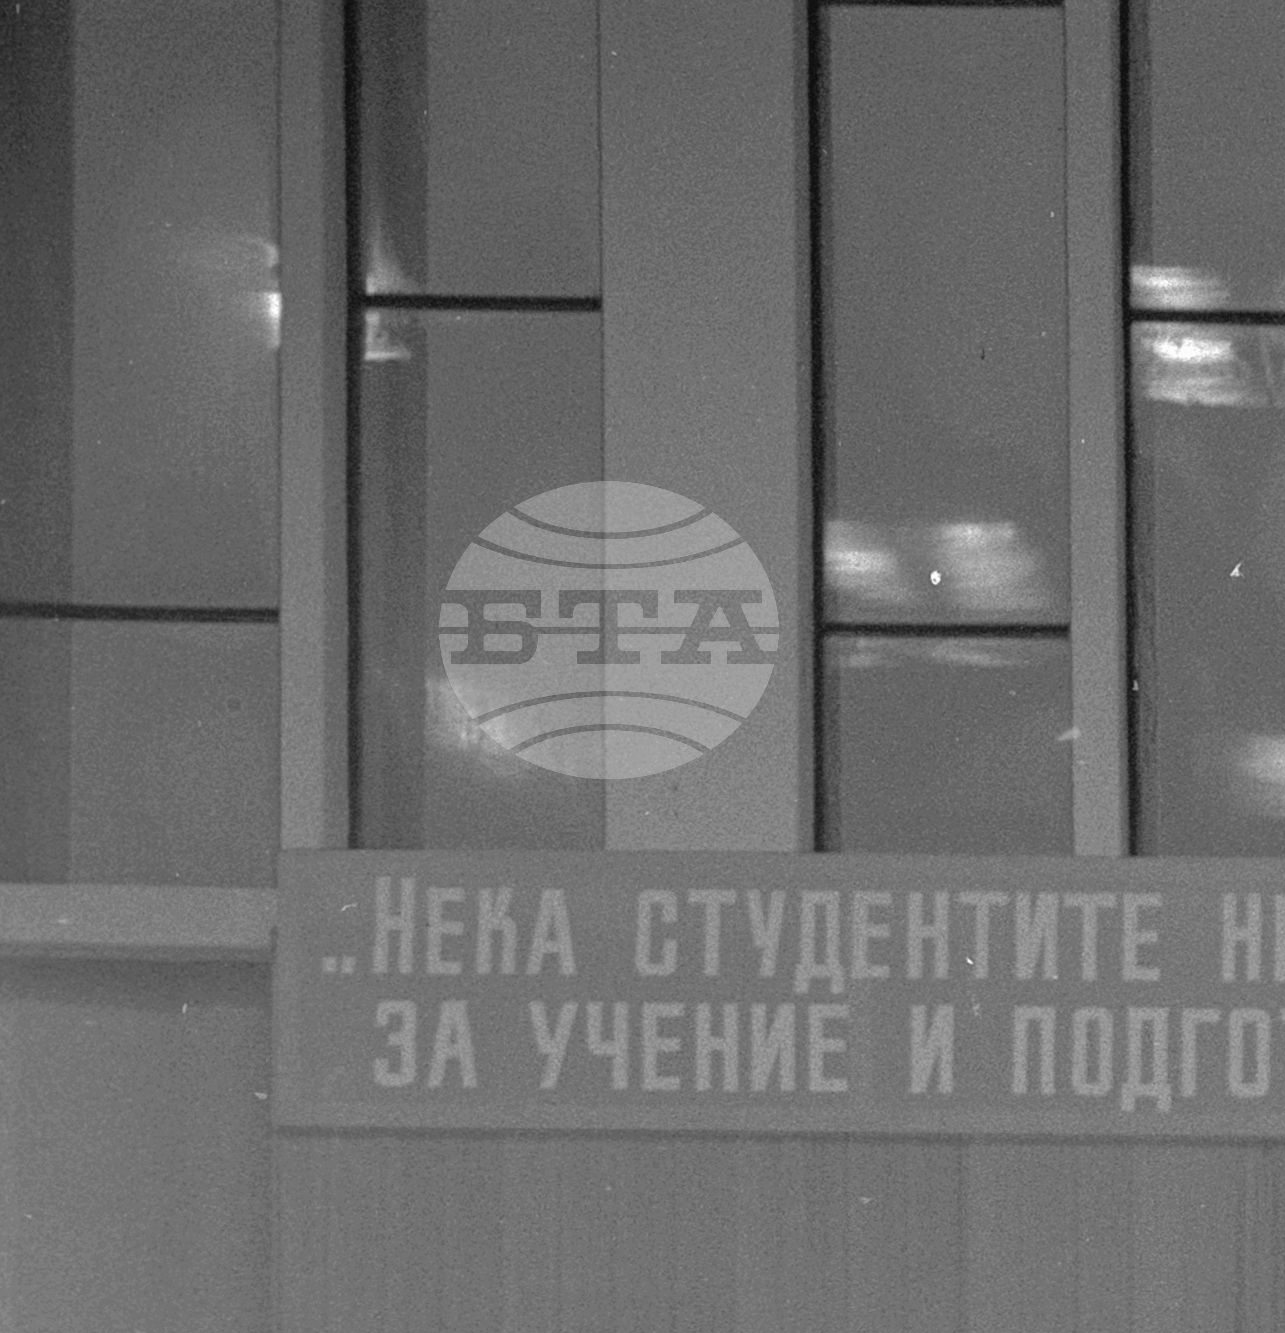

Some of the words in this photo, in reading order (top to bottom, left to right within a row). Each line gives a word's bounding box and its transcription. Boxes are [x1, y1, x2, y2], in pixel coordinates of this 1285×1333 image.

[634, 887, 1162, 994] СТУДЕНТИТЕ
[372, 999, 479, 1089] ЗА
[528, 1001, 852, 1093] УЧЕНИЕ
[908, 1003, 956, 1095] И
